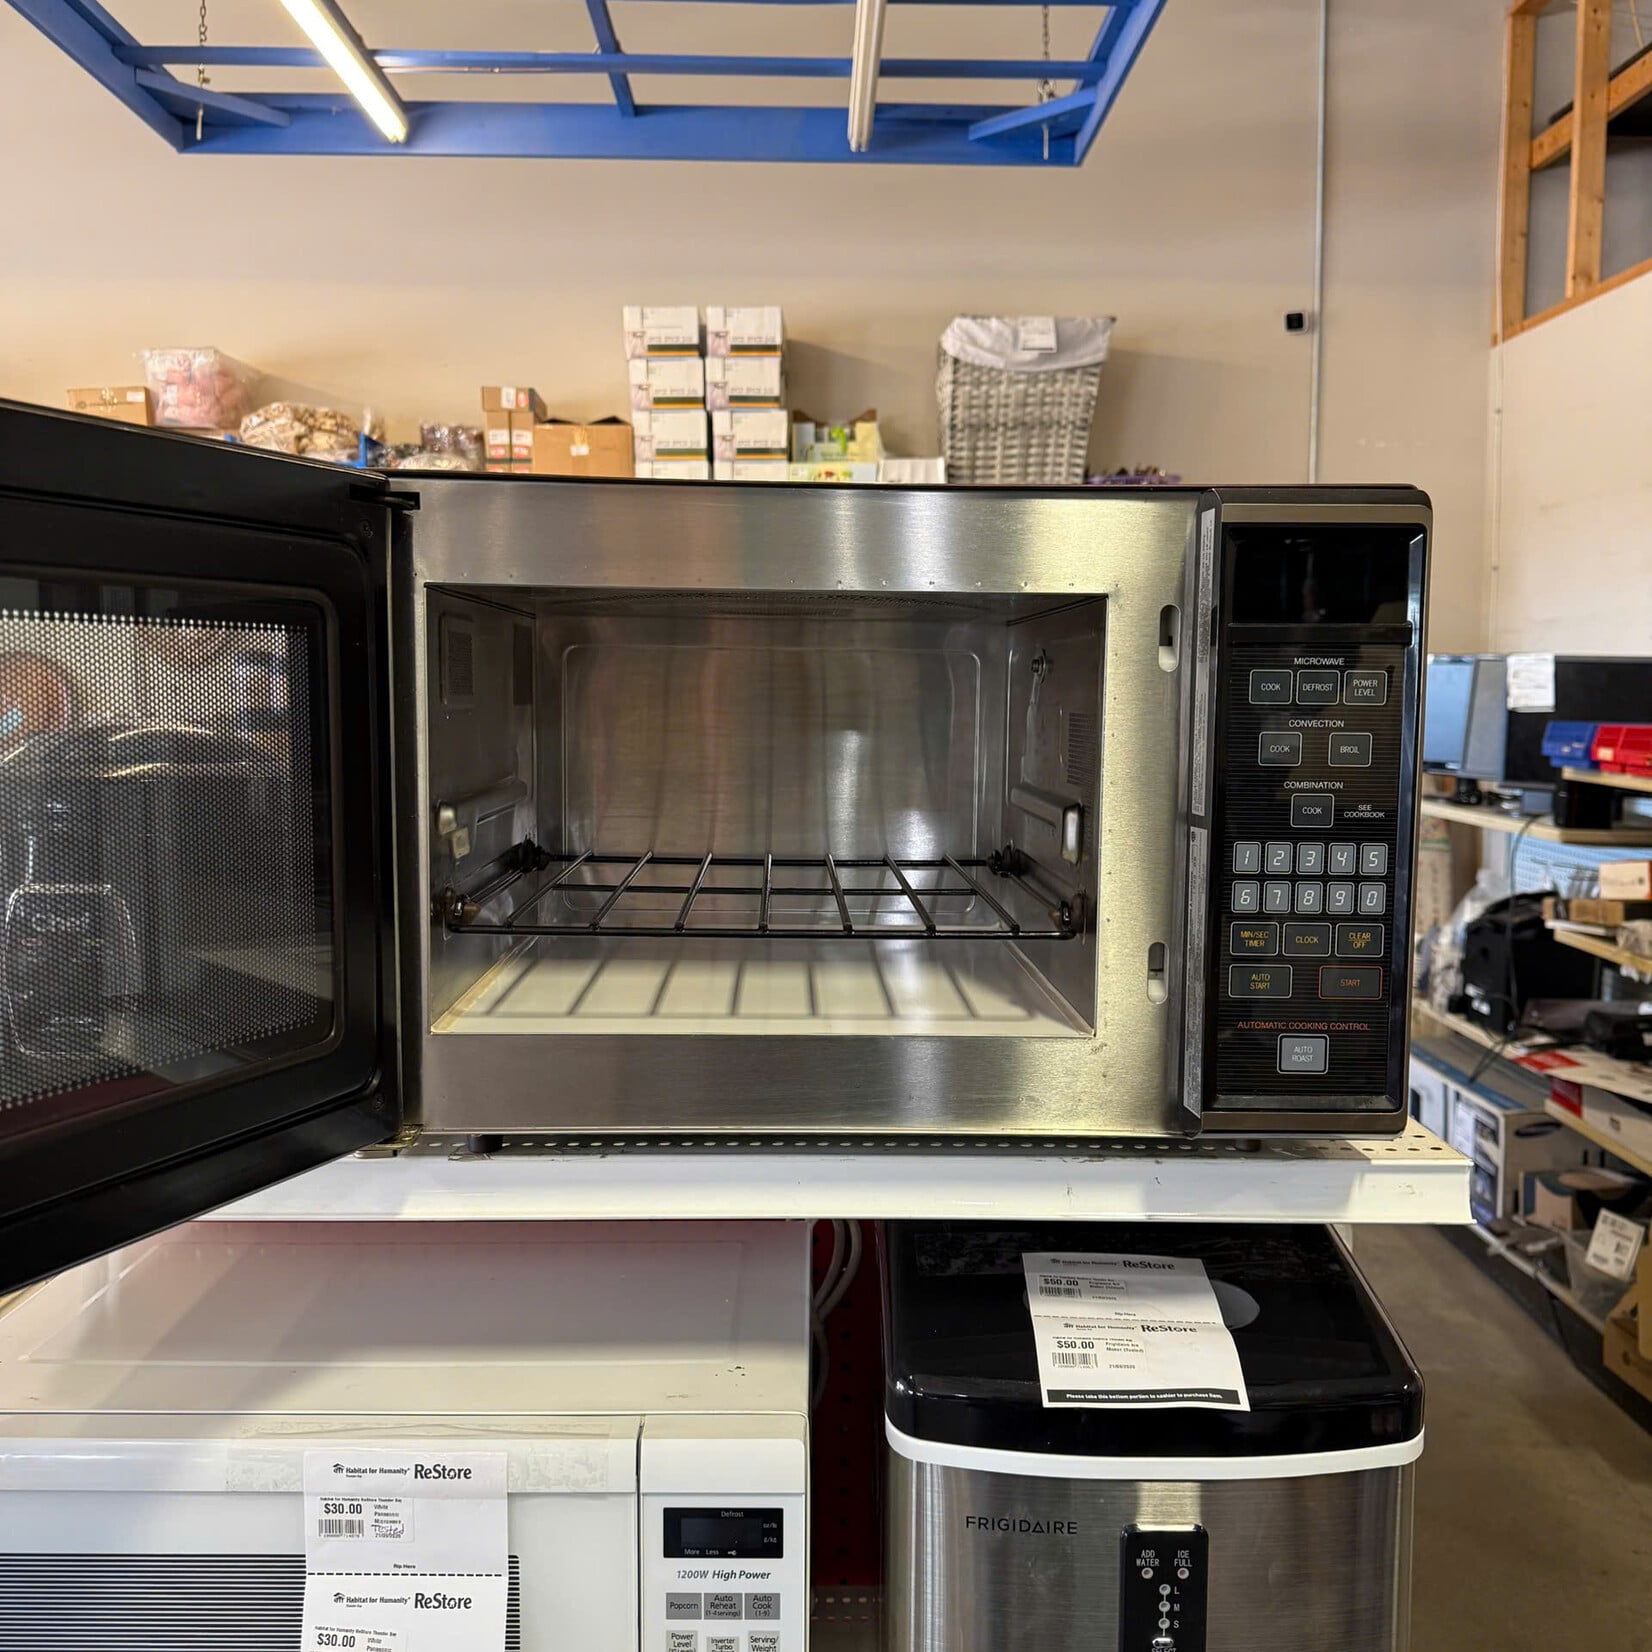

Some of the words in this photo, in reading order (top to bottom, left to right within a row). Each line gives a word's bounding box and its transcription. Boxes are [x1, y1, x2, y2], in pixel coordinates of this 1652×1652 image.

[1294, 657, 1345, 666] MICROWAVE
[1260, 683, 1281, 691] COOK
[1302, 683, 1334, 692] DEFROST
[1352, 679, 1378, 688] POWER
[1353, 688, 1376, 697] LEVEL
[1288, 719, 1345, 728] CONVECTION
[1269, 744, 1290, 753] COOK
[1340, 745, 1360, 754] BROIL
[1283, 781, 1344, 790] COMBINATION
[1302, 806, 1323, 815] COOK
[1244, 850, 1250, 865] 1
[1273, 850, 1285, 865] 2
[1305, 851, 1316, 866] 3
[1337, 851, 1348, 866] 4
[1368, 851, 1379, 867] 5
[1240, 889, 1251, 905] 6
[1273, 890, 1282, 905] 7
[1303, 890, 1315, 905] 8
[1335, 890, 1346, 906] 9
[1366, 891, 1378, 906] 0
[1240, 930, 1269, 939] MIN/SEC
[1349, 932, 1371, 941] CLEAR
[1244, 939, 1265, 948] TIMER
[1295, 935, 1319, 944] CLOCK
[1352, 941, 1367, 949] OFF
[1251, 973, 1271, 982] AUTO
[1250, 981, 1271, 990] START
[1340, 978, 1361, 987] START
[1237, 1021, 1287, 1030] AUTOMATIC
[1288, 1021, 1329, 1031] COOKING
[1329, 1022, 1371, 1031] CONTROL
[1293, 1045, 1314, 1054] AUTO
[1291, 1054, 1314, 1063] ROAST
[1122, 1259, 1176, 1271] ReStore
[1043, 1277, 1080, 1288] $50.00
[1140, 1323, 1198, 1334] ReStore
[1056, 1340, 1095, 1350] $50.00
[345, 1466, 368, 1475] Habitat
[369, 1466, 378, 1475] for
[379, 1466, 408, 1476] Humanity
[414, 1463, 472, 1480] ReStore
[323, 1503, 363, 1515] $30.00
[965, 1515, 1078, 1535] FRIGIDAIRE
[1140, 1549, 1156, 1558] ADD
[1177, 1550, 1190, 1558] ICE
[1135, 1558, 1160, 1567] WATER
[1173, 1558, 1193, 1567] FULL
[676, 1570, 709, 1579] 1200W
[712, 1570, 737, 1581] High
[739, 1570, 772, 1580] Power
[1174, 1585, 1180, 1595] L
[346, 1595, 368, 1604] Habitat
[369, 1595, 378, 1604] for
[379, 1596, 409, 1606] Humanity
[414, 1592, 472, 1610] ReStore
[669, 1602, 699, 1610] Popcorn
[1173, 1603, 1180, 1612] M
[1173, 1620, 1180, 1629] S
[316, 1632, 356, 1648] $30.00
[750, 1635, 779, 1645] Serving/
[751, 1644, 777, 1652] Weight
